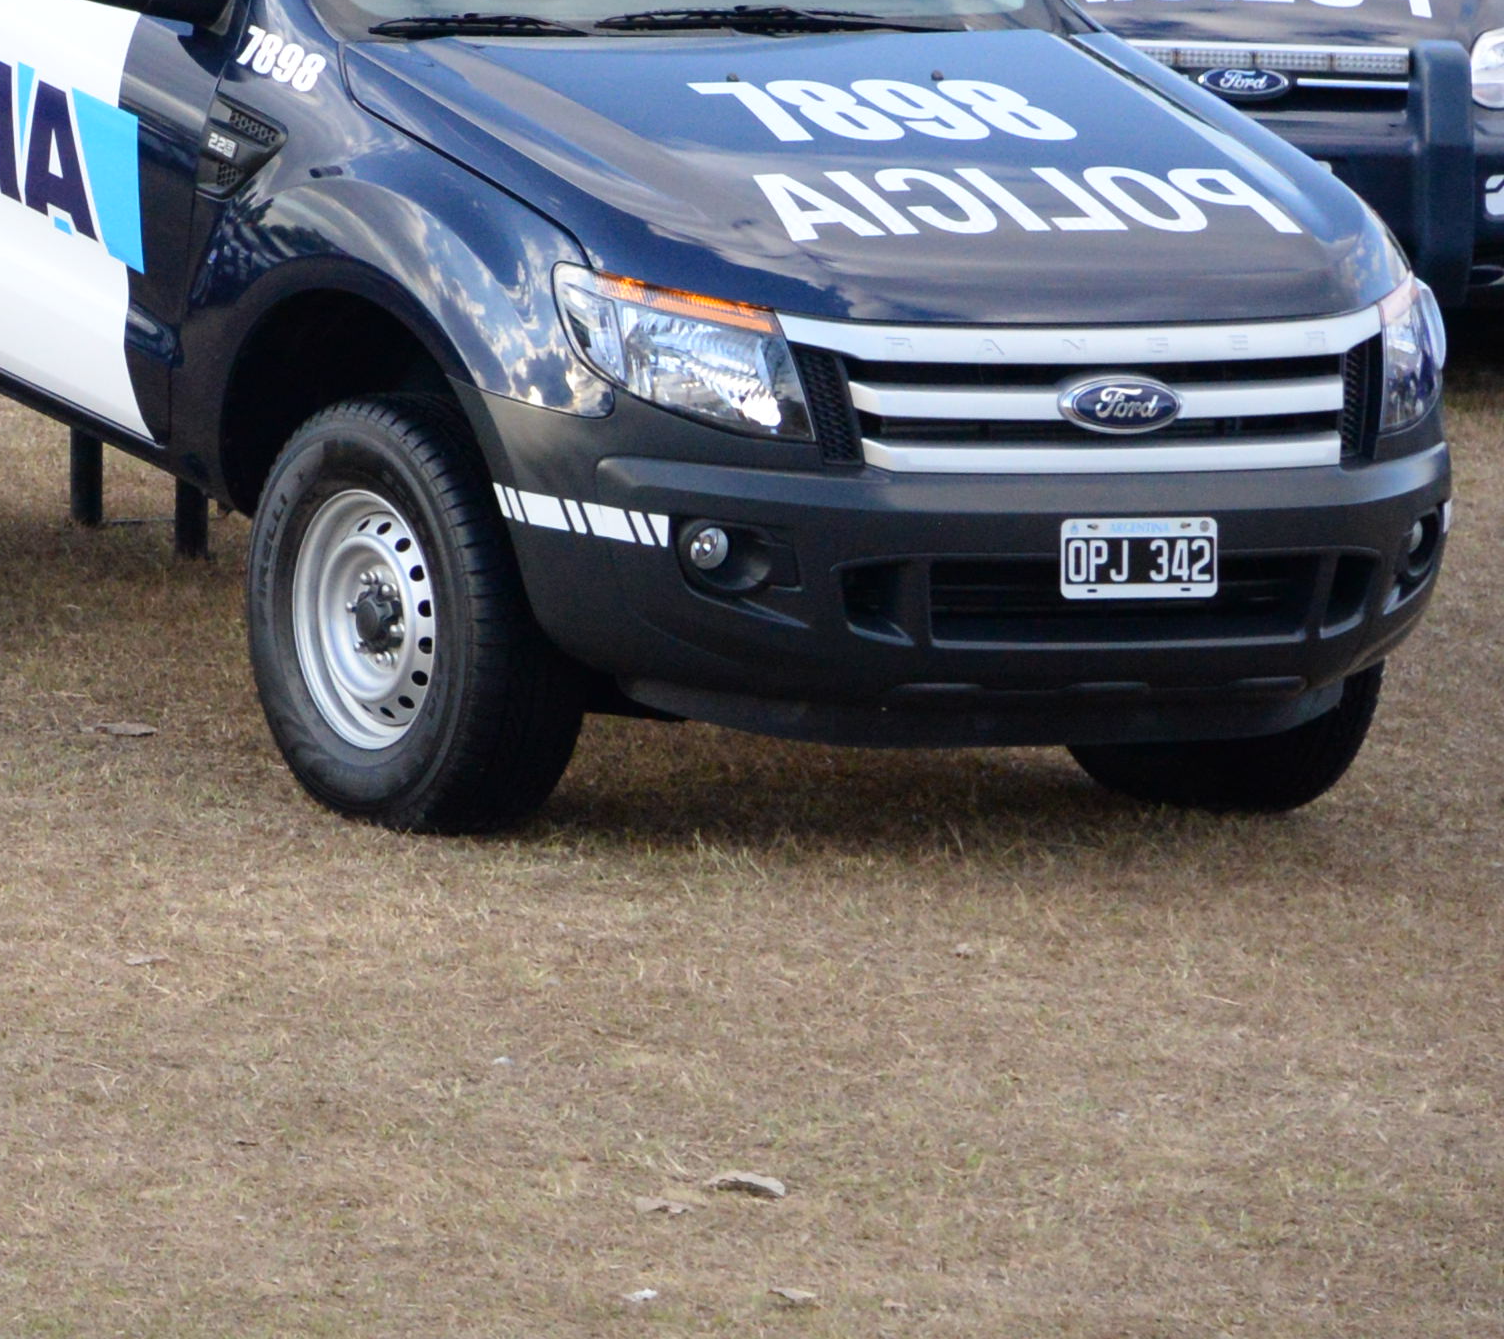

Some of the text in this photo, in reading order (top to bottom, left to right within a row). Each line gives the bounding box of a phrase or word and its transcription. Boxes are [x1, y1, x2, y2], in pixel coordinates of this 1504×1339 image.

[236, 24, 328, 93] 7898
[1219, 69, 1268, 91] Ford
[687, 80, 1079, 143] 7898
[1094, 386, 1160, 421] Ford
[1109, 521, 1171, 534] ARGENTINA
[1068, 537, 1212, 583] OPJ 342
